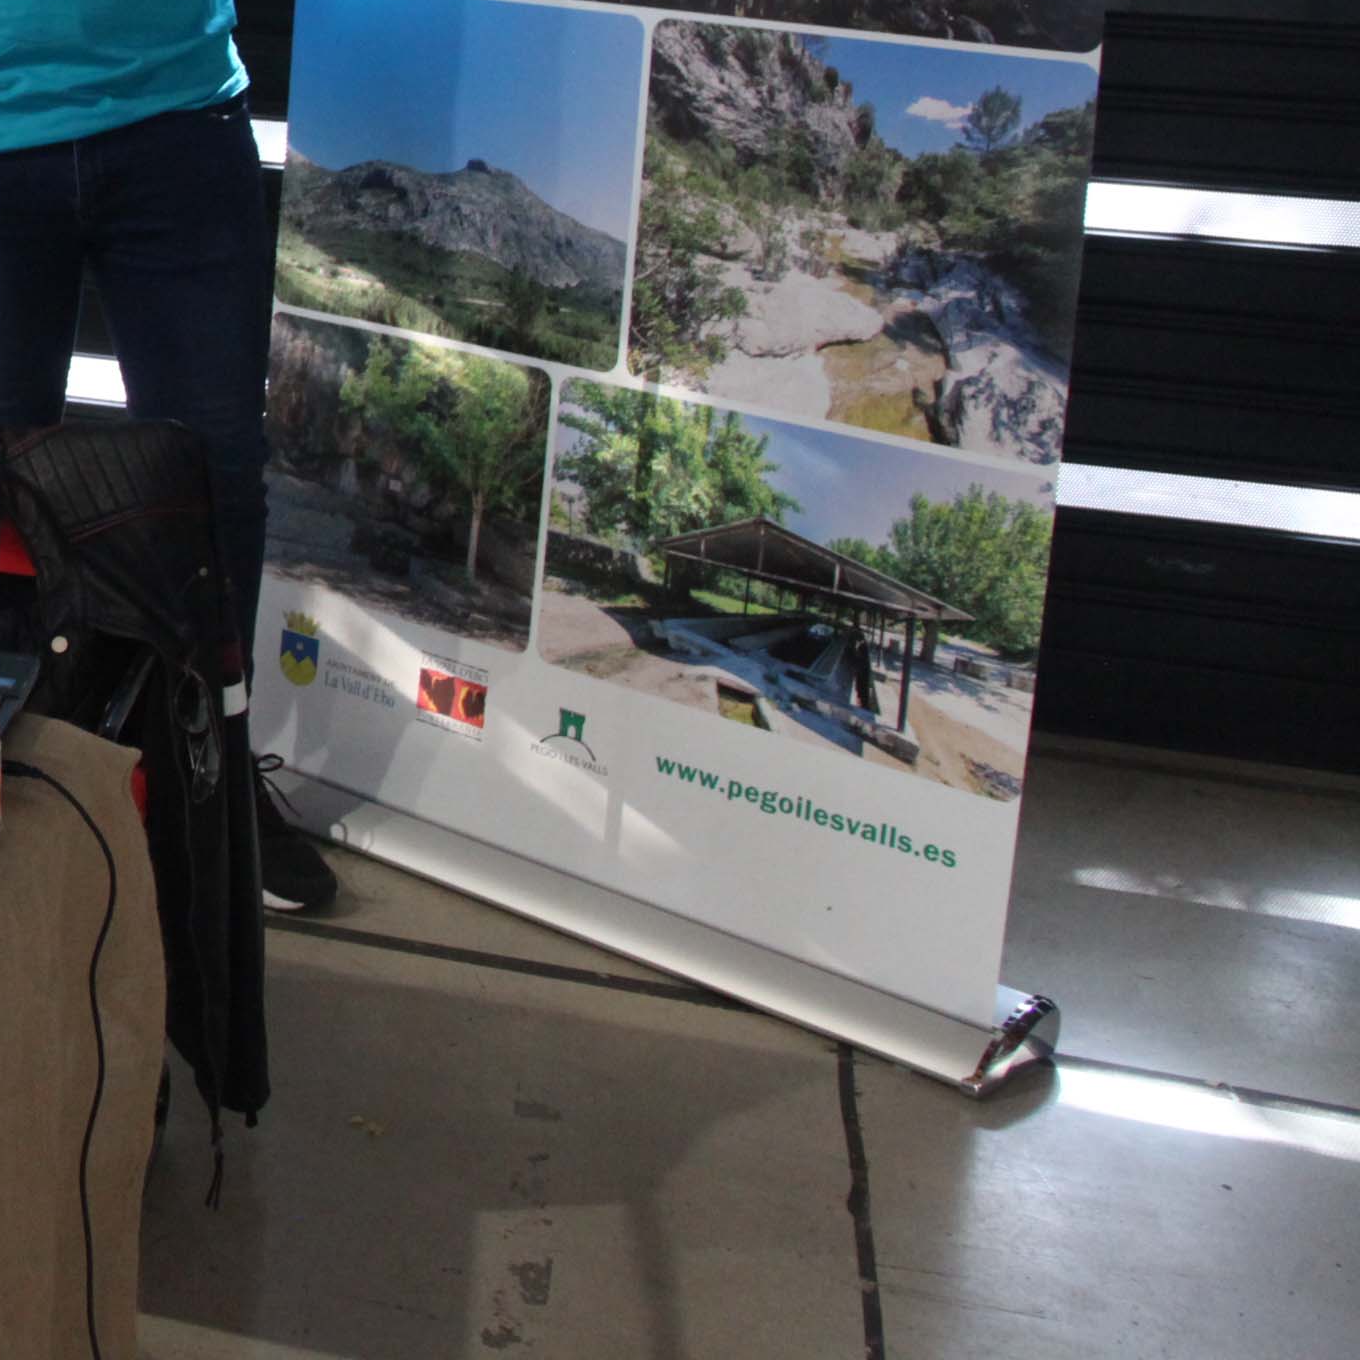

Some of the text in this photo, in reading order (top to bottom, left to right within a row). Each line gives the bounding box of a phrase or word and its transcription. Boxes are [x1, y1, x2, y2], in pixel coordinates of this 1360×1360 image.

[530, 742, 558, 760] PEGO
[564, 751, 581, 769] LES
[581, 758, 609, 777] VALLS
[655, 753, 958, 870] www.pegoilesvalls.es
